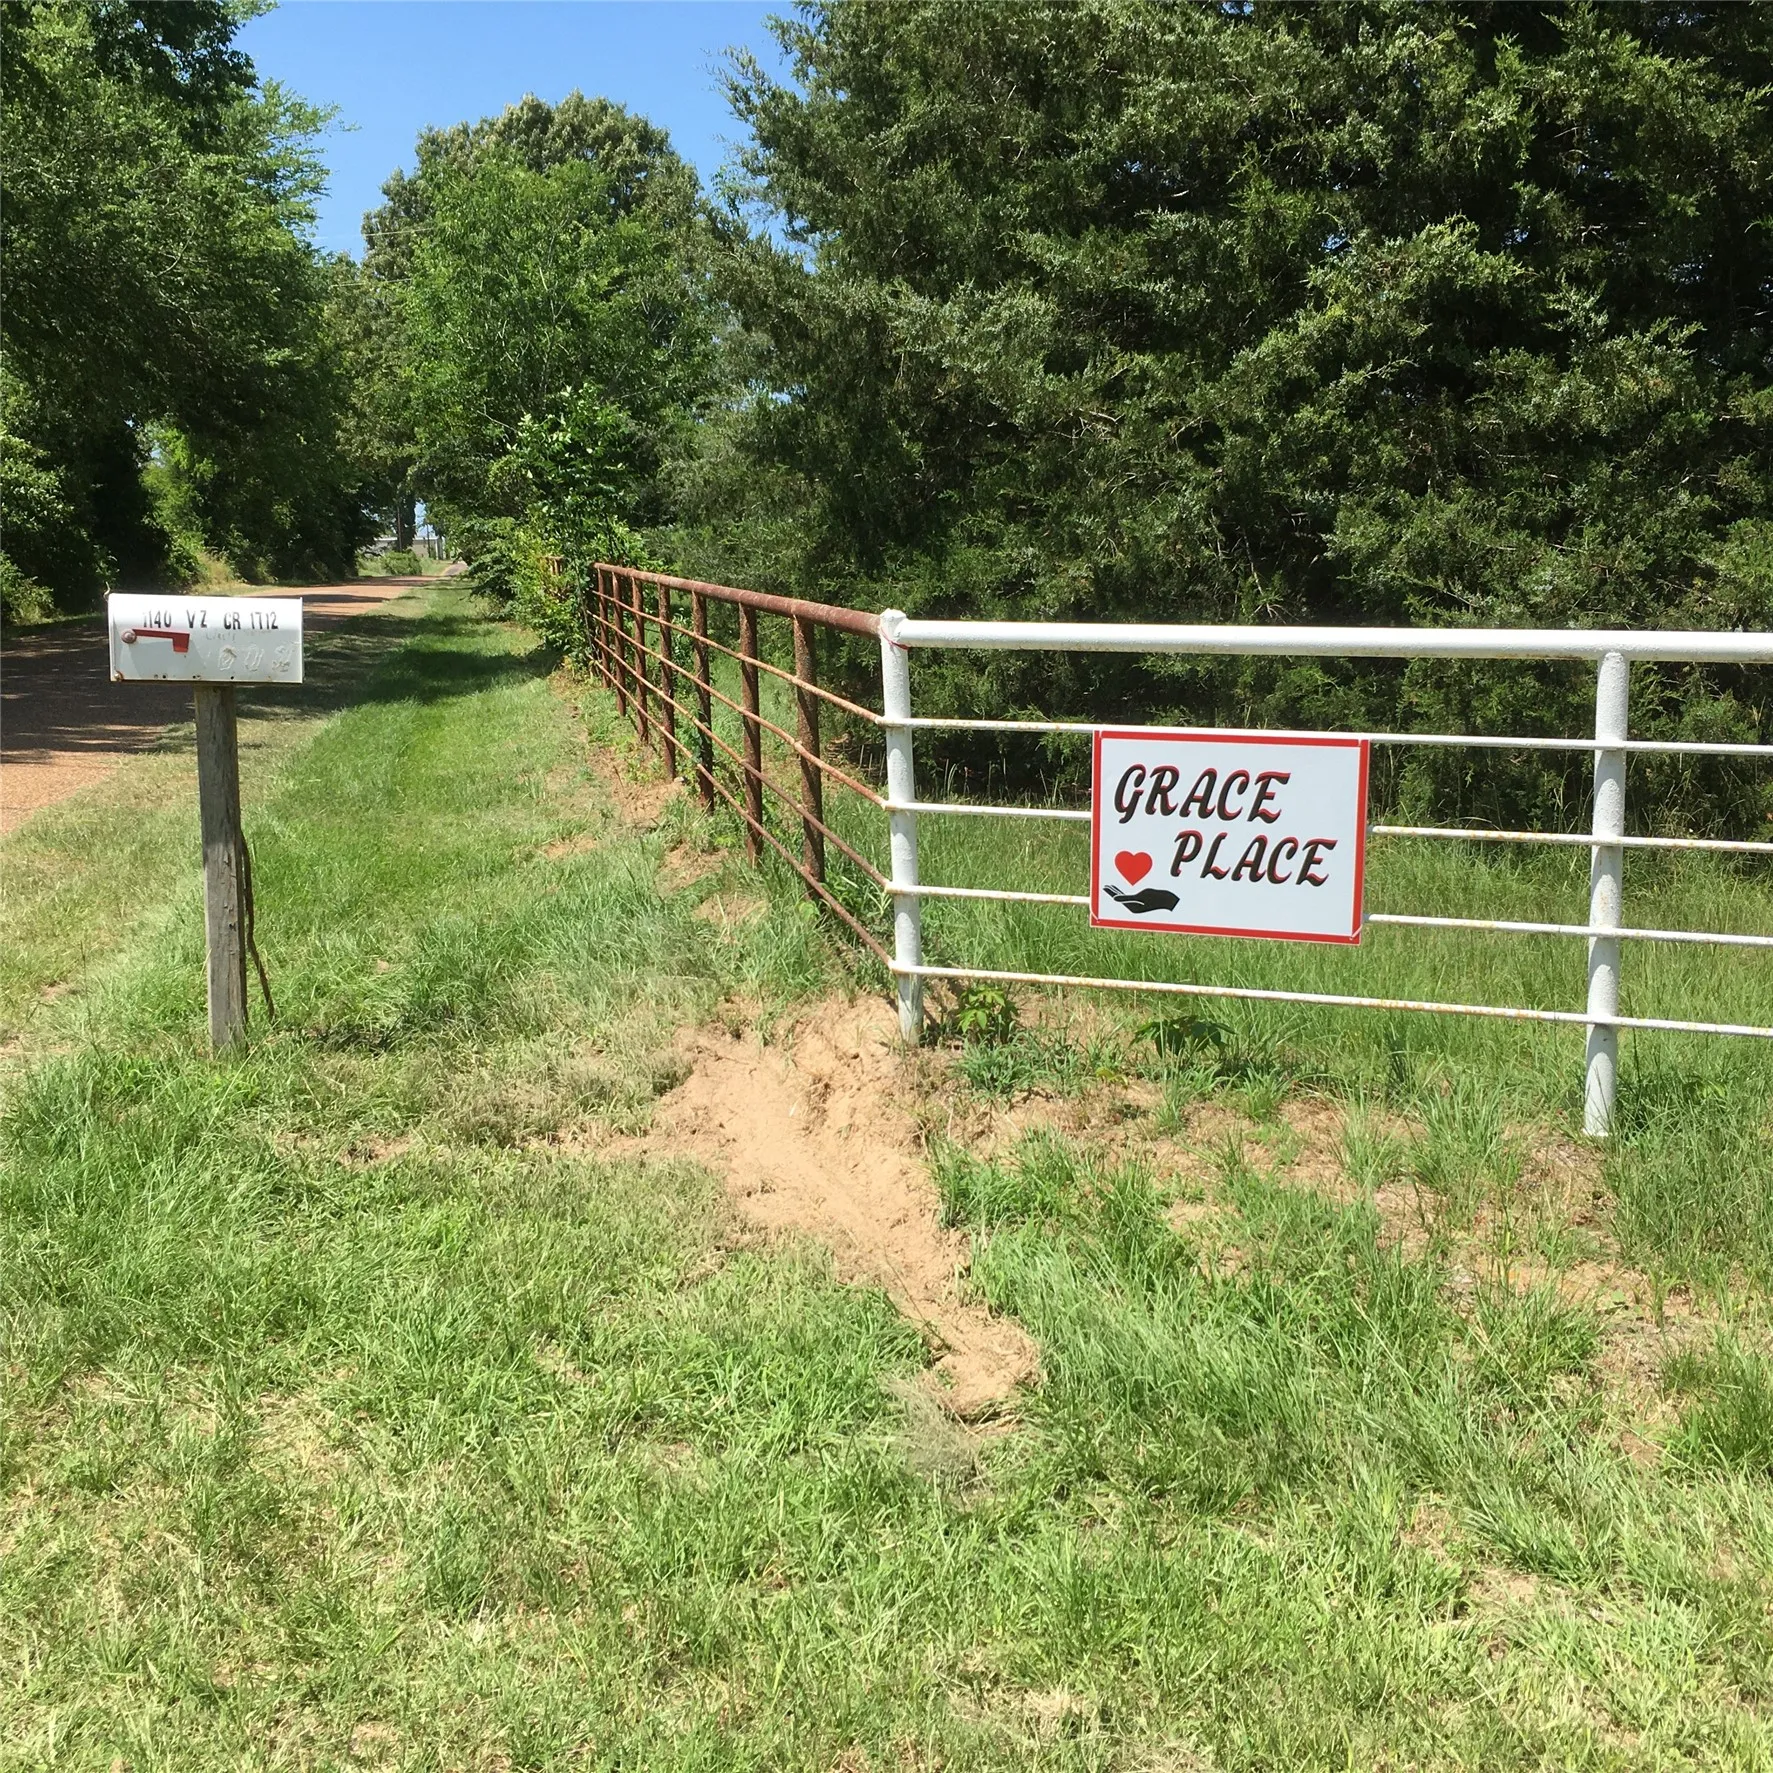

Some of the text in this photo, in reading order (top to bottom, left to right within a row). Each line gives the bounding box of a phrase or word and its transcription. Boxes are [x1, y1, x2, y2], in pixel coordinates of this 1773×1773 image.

[224, 611, 241, 630] CR
[1114, 763, 1291, 824] GRACE
[1170, 829, 1338, 887] PLACE
